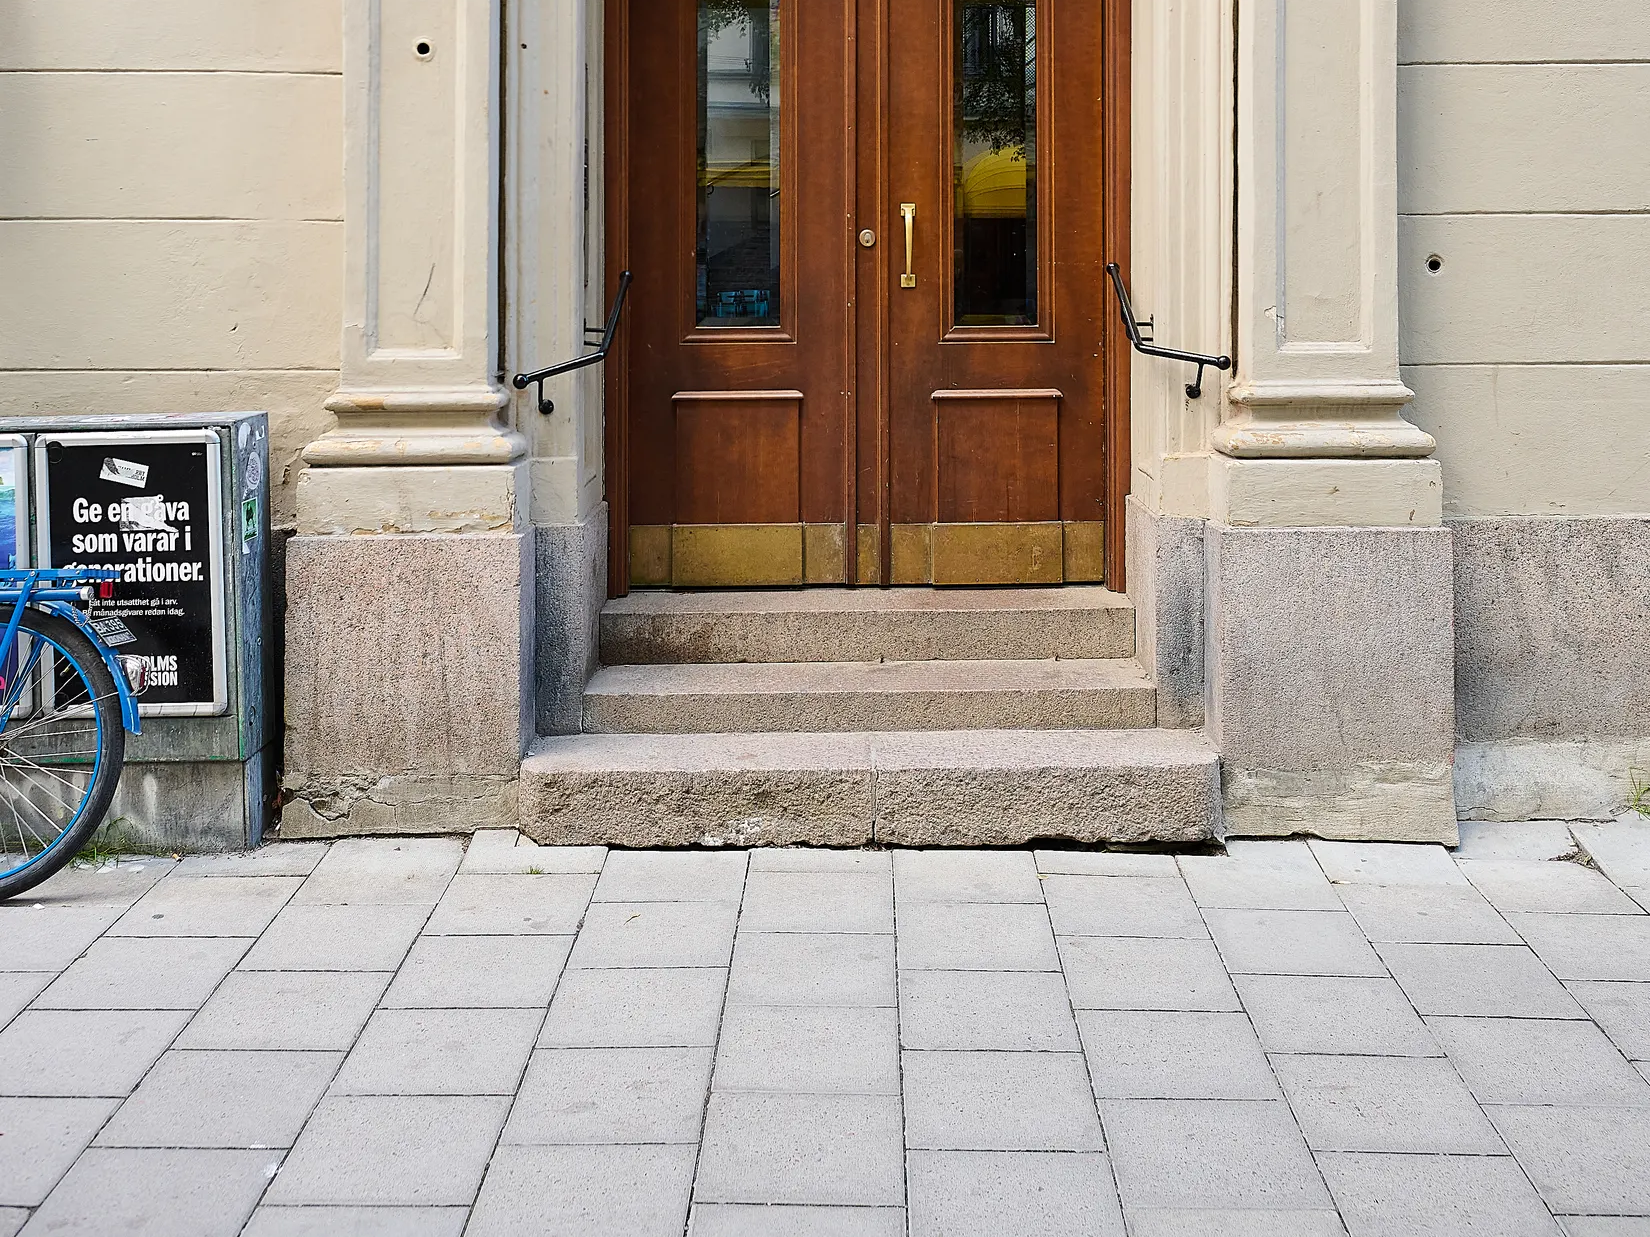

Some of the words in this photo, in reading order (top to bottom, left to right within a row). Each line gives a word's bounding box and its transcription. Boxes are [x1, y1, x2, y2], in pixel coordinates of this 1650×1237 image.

[72, 496, 103, 524] Ge
[107, 501, 132, 523] en
[72, 533, 118, 553] som
[121, 531, 180, 553] varar
[185, 525, 192, 551] i
[101, 599, 116, 607] inte
[116, 599, 149, 607] utsatthet
[164, 598, 178, 606] arv.
[93, 608, 144, 618] månadsgivare
[144, 608, 166, 616] redan
[167, 607, 185, 617] idag.
